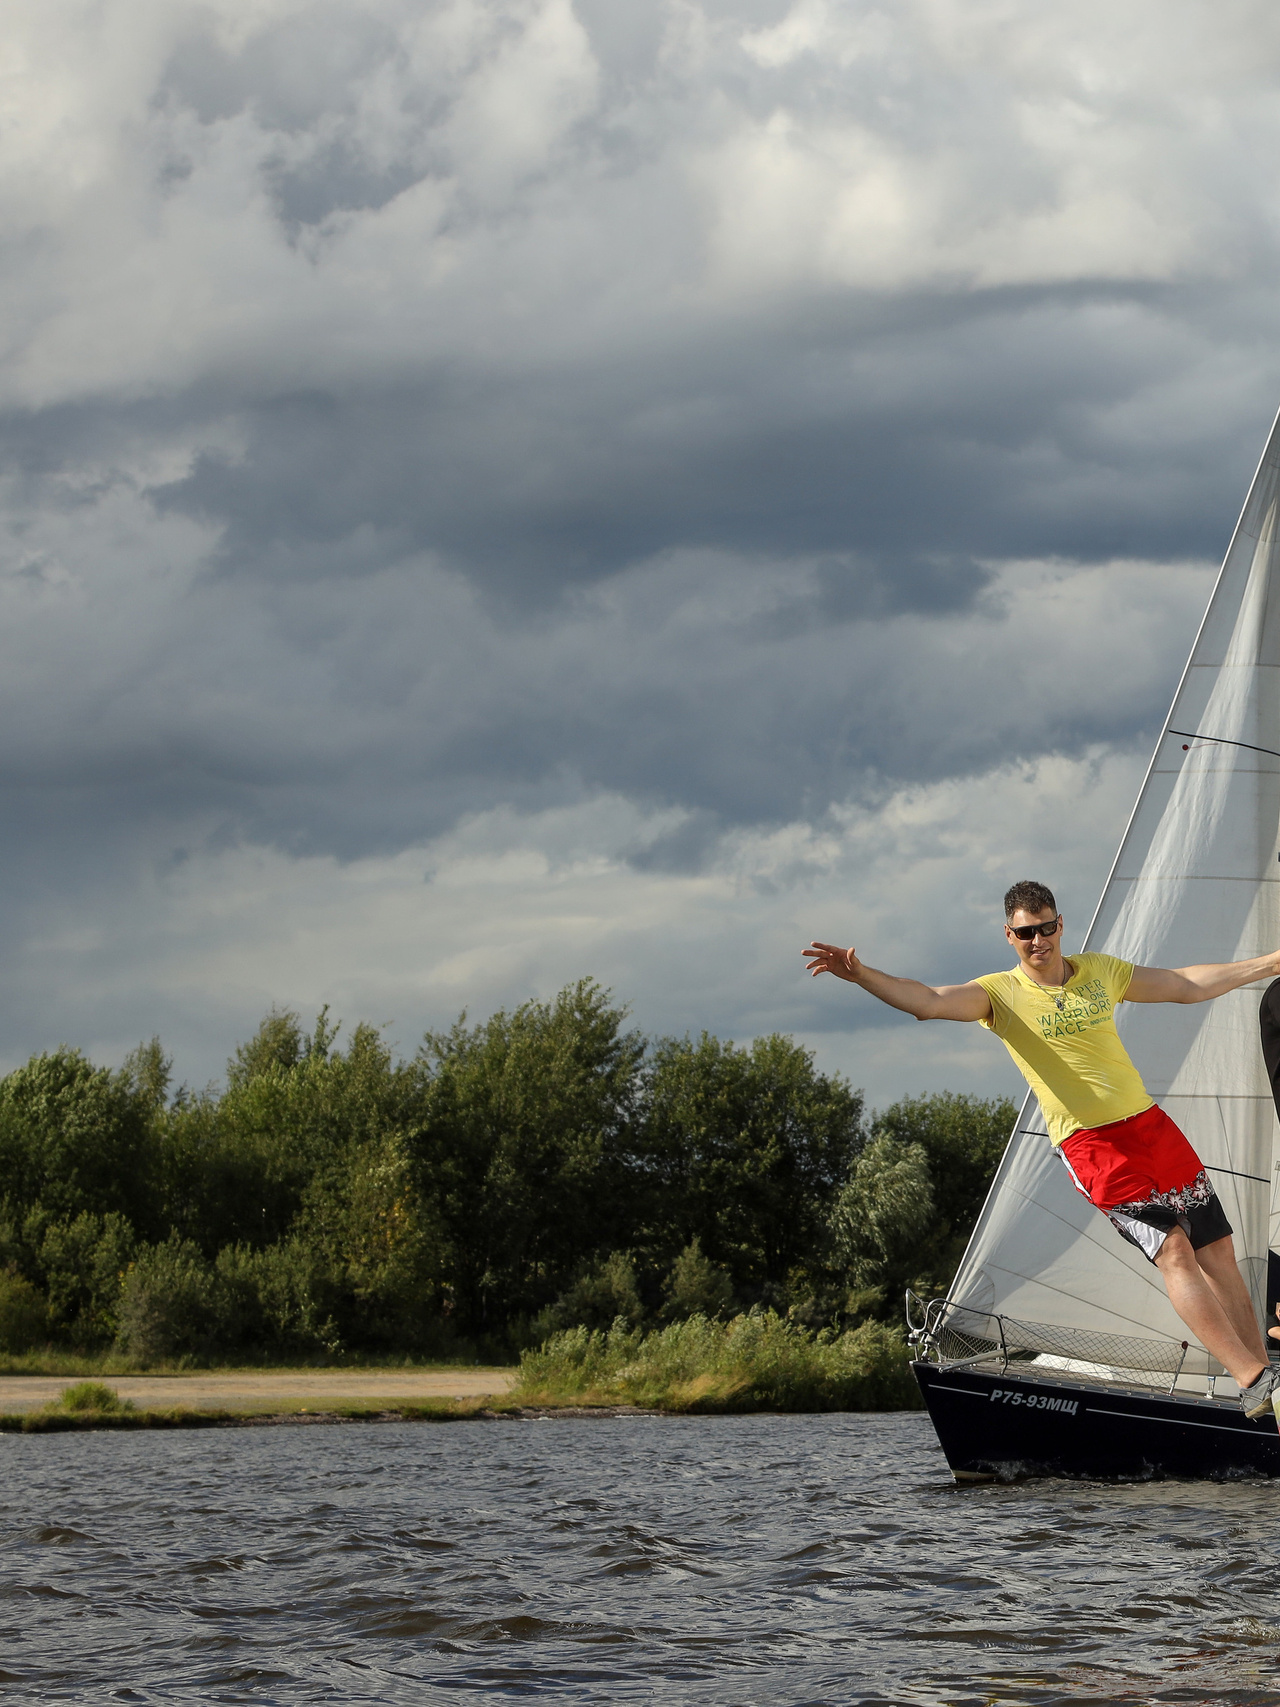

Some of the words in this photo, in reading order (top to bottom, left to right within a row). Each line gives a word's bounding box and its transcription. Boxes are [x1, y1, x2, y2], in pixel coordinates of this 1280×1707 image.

[1062, 978, 1106, 1001] UPER
[1089, 989, 1109, 1001] ONE
[1042, 1020, 1087, 1040] RACE
